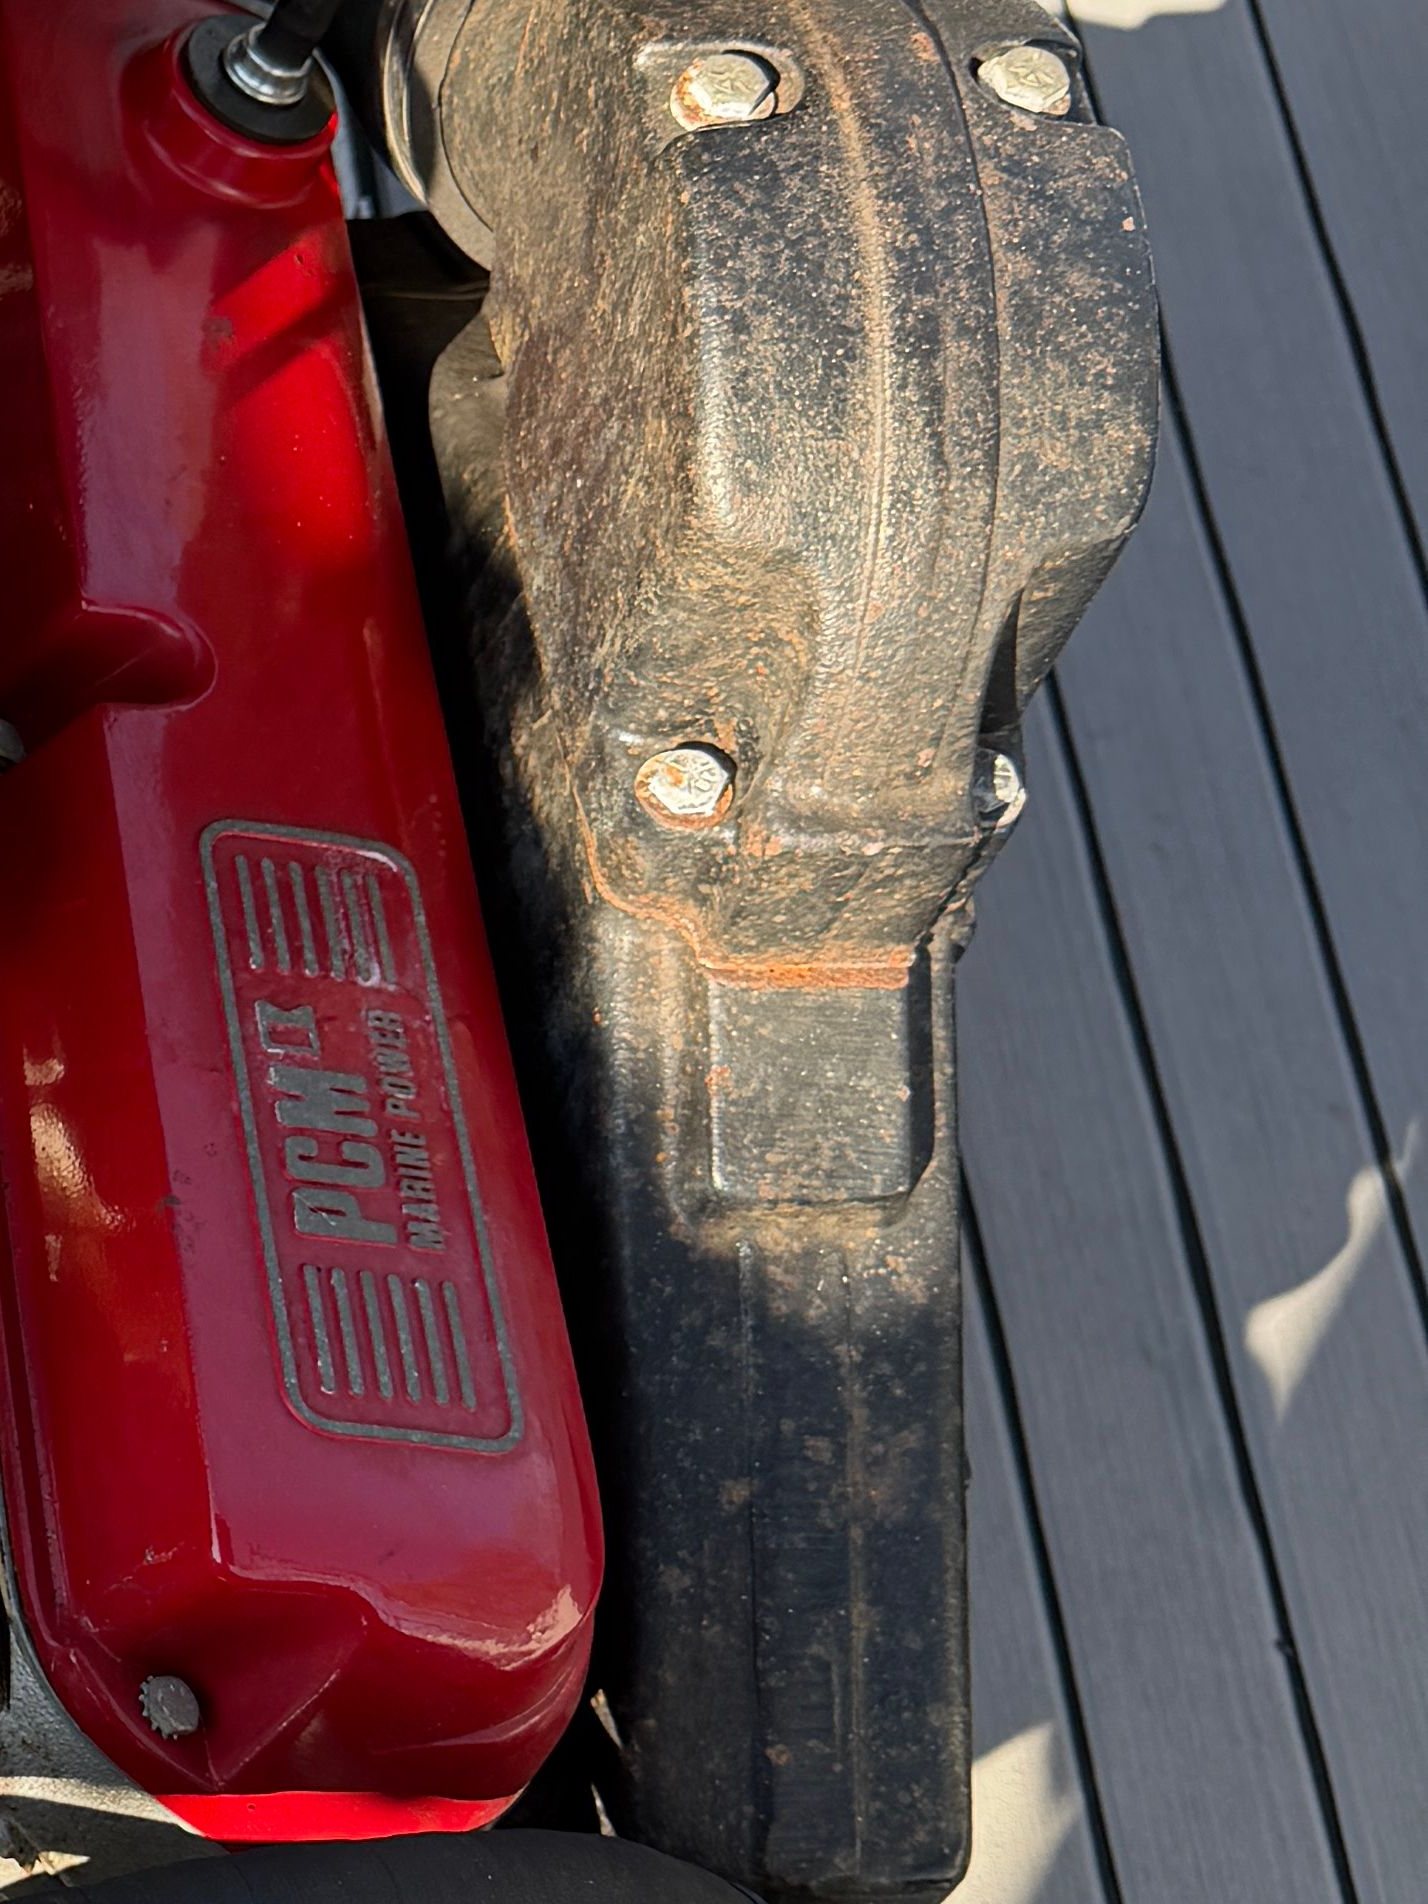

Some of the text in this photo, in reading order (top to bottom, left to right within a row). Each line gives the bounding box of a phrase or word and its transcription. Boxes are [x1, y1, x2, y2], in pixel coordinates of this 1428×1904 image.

[268, 1065, 396, 1246] PCM
[367, 1008, 446, 1251] MARINE POWER
